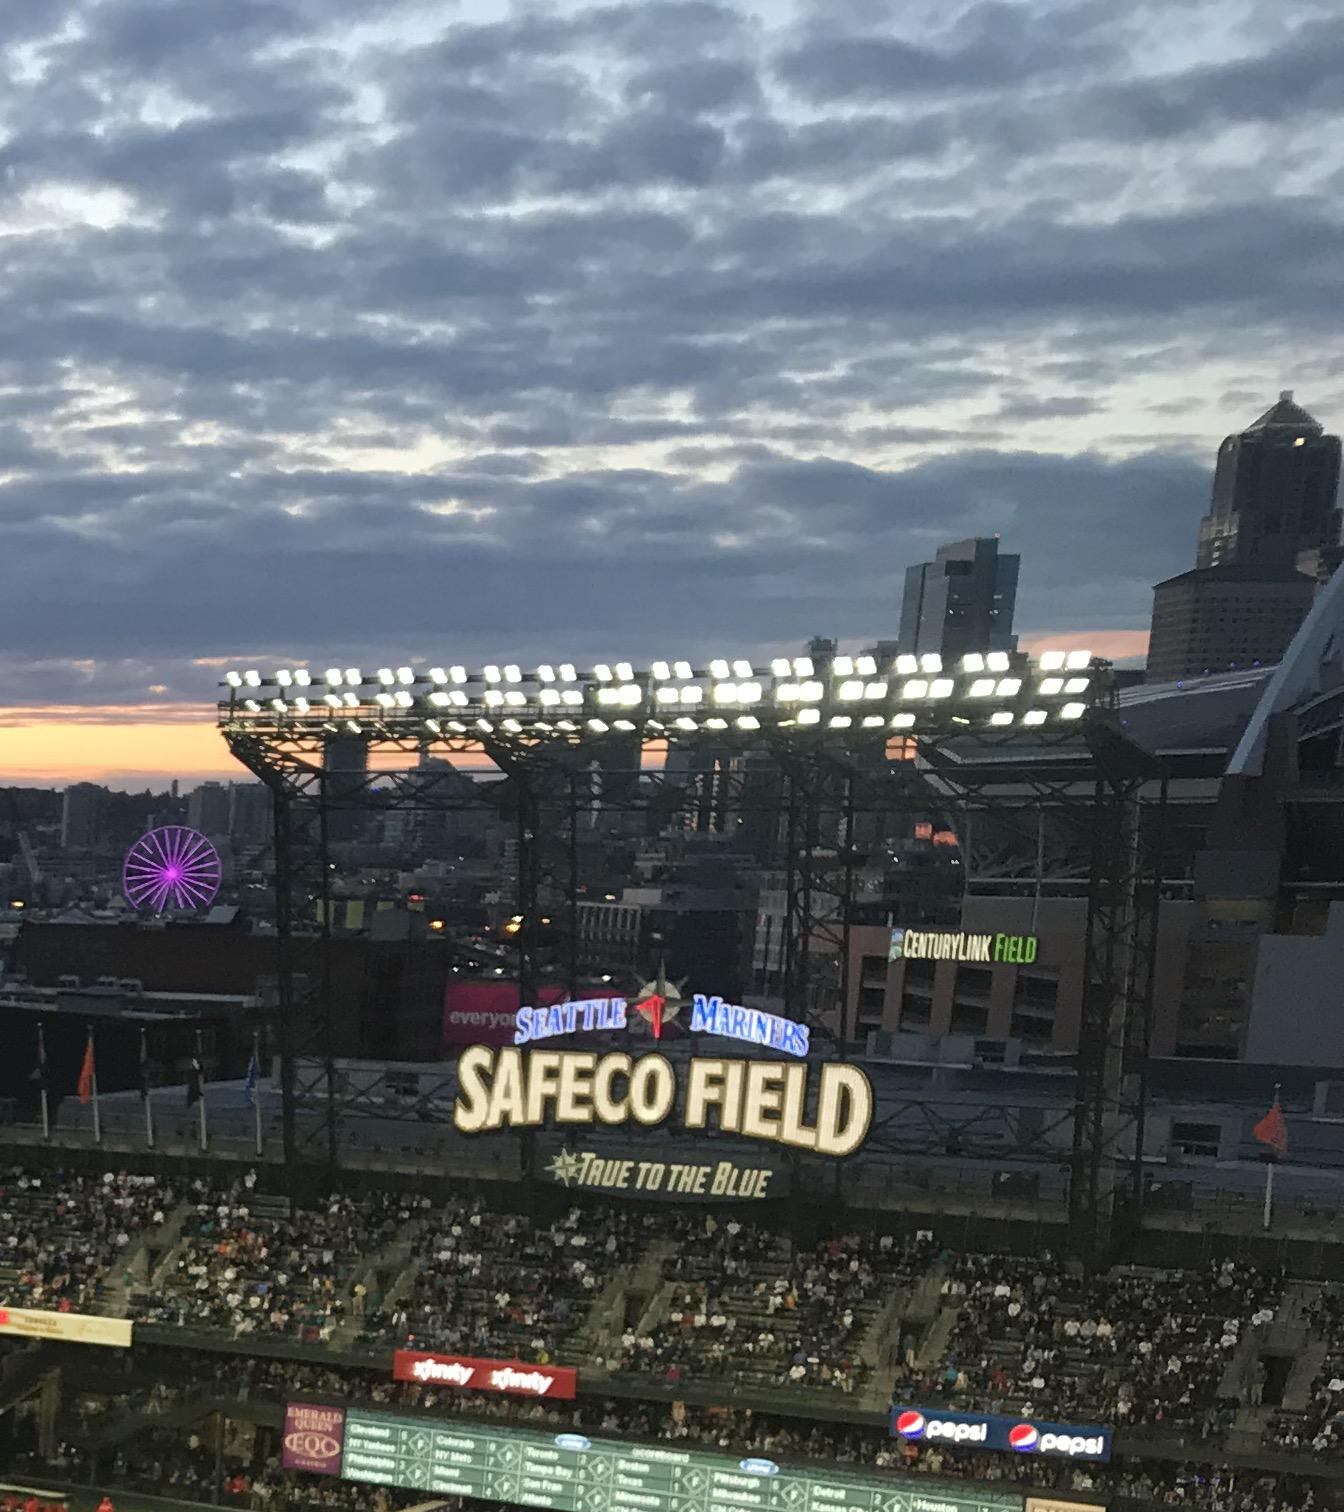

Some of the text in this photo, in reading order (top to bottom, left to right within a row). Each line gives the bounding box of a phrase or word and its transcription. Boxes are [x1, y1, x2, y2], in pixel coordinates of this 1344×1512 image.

[514, 994, 811, 1057] SEATTLE MARINERS
[454, 1043, 873, 1156] SAFECO FIELD
[926, 1420, 987, 1442] pepsi
[1040, 1433, 1104, 1456] pepsi
